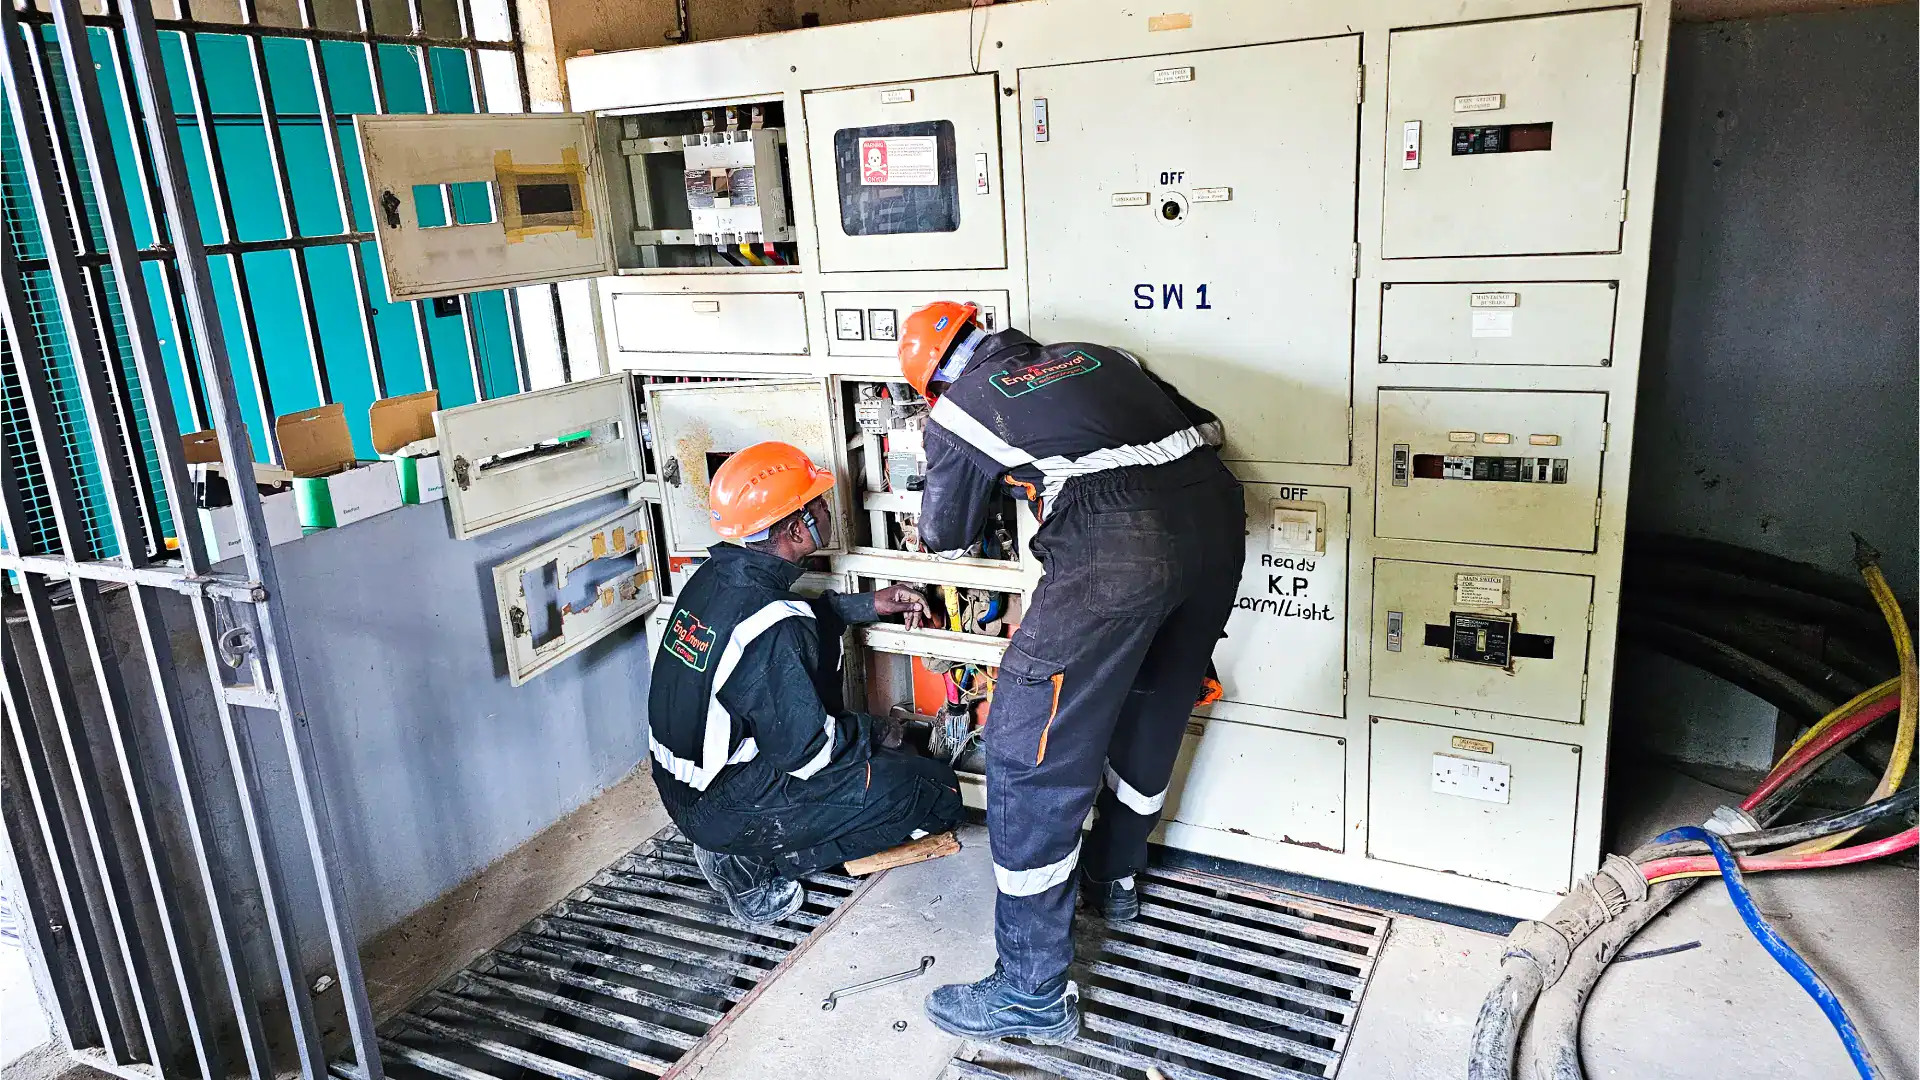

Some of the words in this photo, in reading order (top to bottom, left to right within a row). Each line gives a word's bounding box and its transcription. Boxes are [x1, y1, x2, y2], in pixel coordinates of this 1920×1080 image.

[1160, 171, 1185, 185] OFF
[1133, 283, 1184, 310] SW
[1195, 283, 1212, 310] 1
[1279, 486, 1308, 501] OFF
[1261, 553, 1316, 572] Ready
[1268, 574, 1309, 598] K.P.
